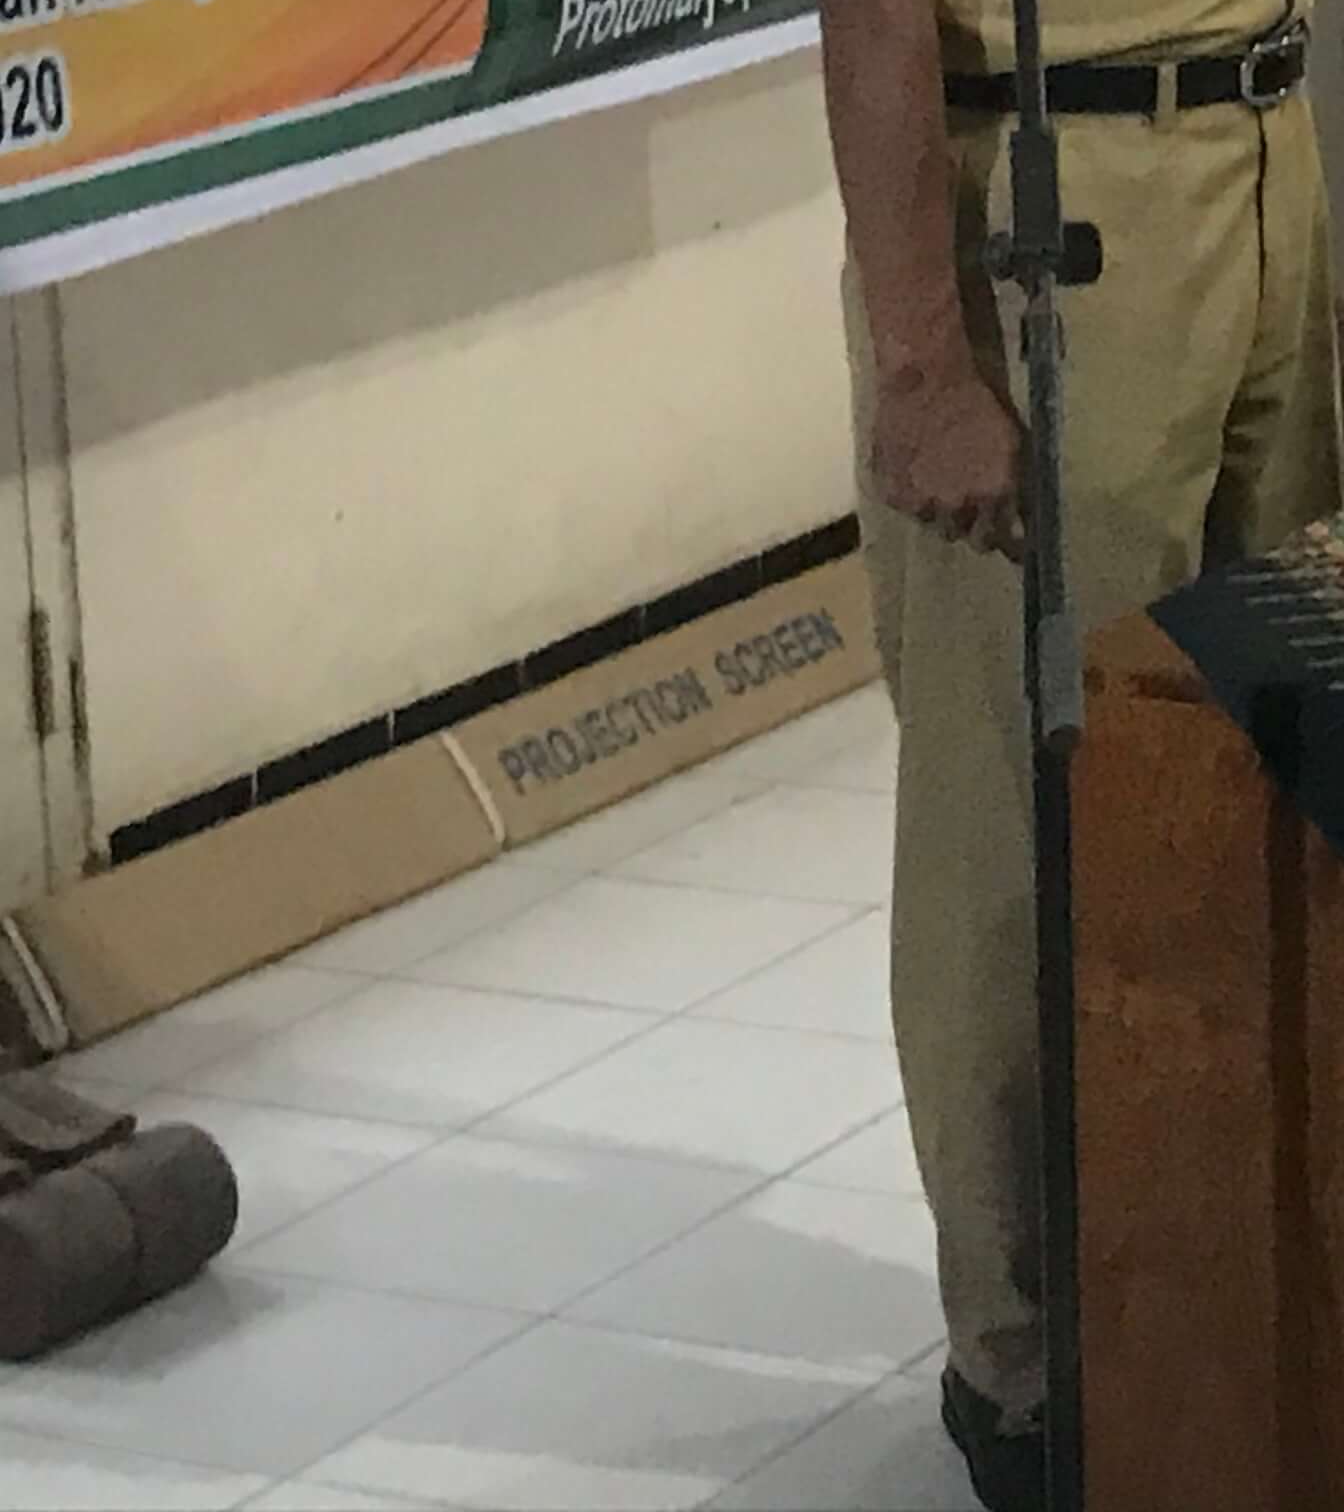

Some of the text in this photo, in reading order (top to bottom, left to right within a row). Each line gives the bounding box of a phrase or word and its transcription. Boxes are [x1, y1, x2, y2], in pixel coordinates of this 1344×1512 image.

[0, 55, 64, 144] 20
[497, 607, 846, 796] PROJECTION SCREEN
